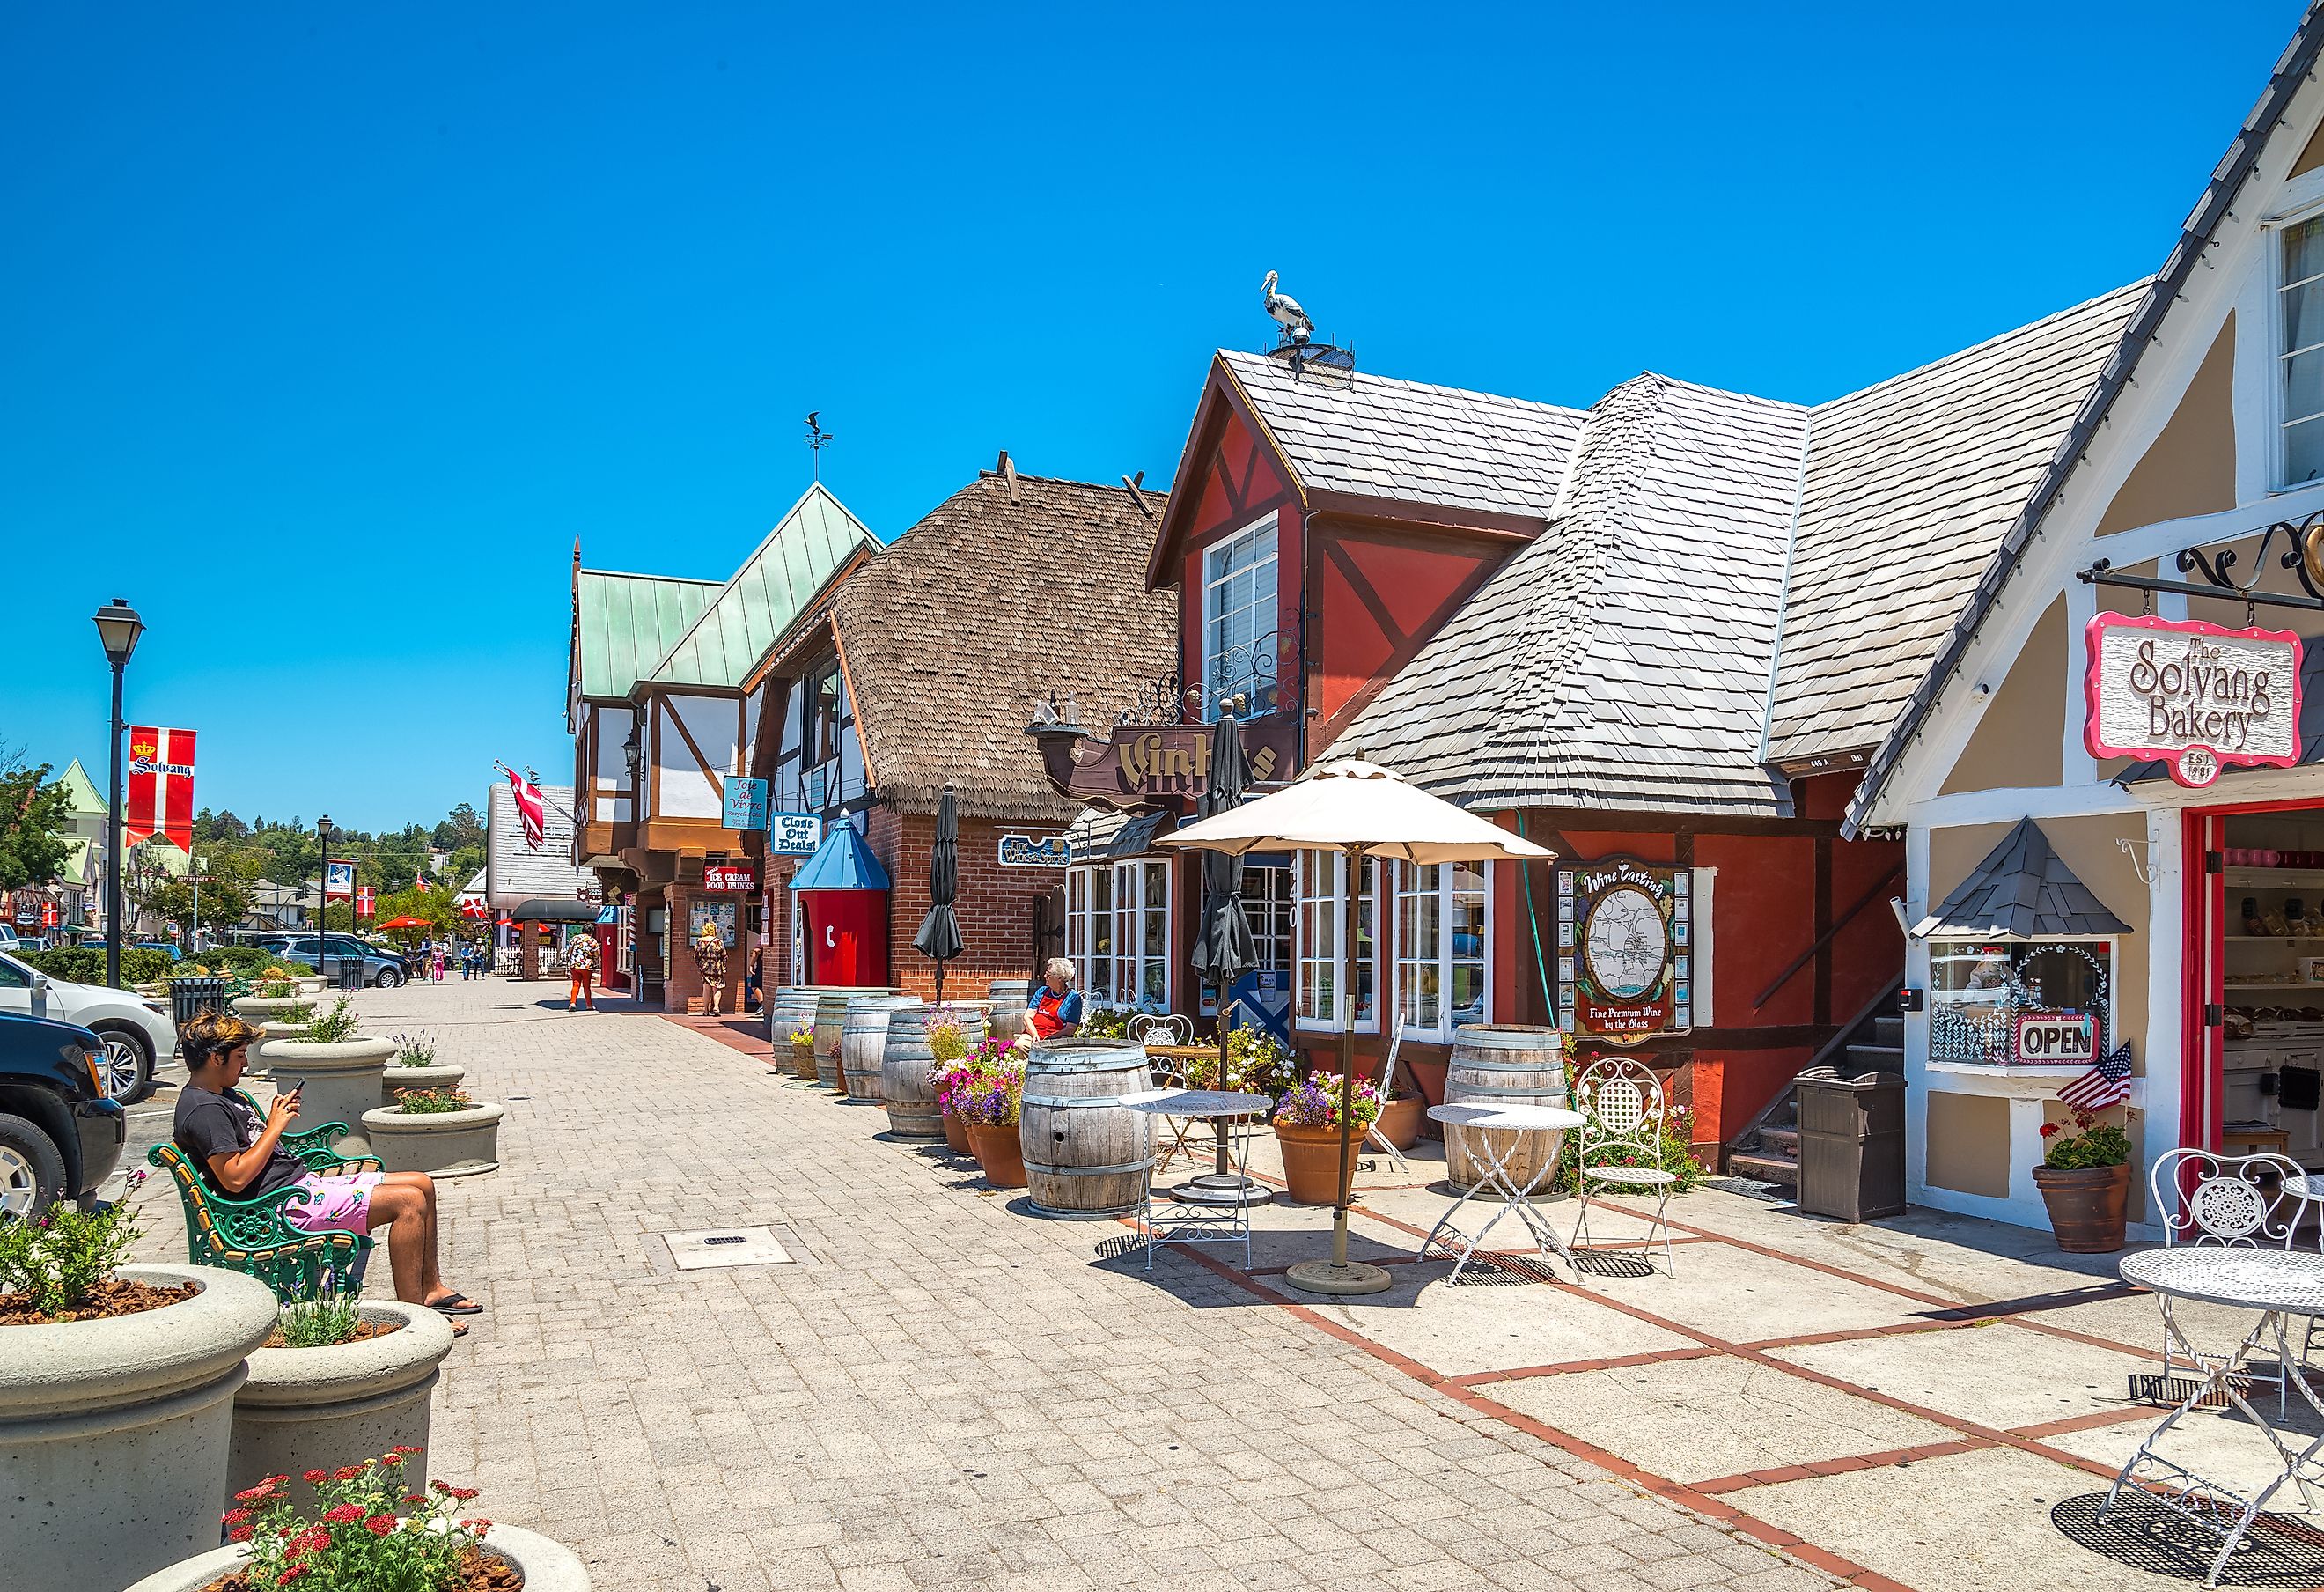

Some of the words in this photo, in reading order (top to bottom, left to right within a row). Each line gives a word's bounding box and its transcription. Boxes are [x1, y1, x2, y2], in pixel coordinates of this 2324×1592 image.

[2189, 636, 2221, 660] The
[2129, 639, 2271, 717] Solvang
[2149, 695, 2253, 750] Bakery
[1119, 732, 1277, 785] Vinhs
[2188, 753, 2210, 765] EST
[132, 756, 191, 778] Solvang
[2188, 766, 2210, 778] 1981
[733, 779, 758, 791] Joie
[739, 790, 753, 800] de
[728, 798, 762, 811] Vivre
[781, 816, 813, 829] Close
[785, 828, 809, 840] Out
[778, 837, 816, 851] Deals!
[1011, 839, 1029, 852] Fine
[724, 873, 751, 882] CREAM
[1583, 871, 1617, 894] Wine
[1617, 863, 1664, 899] Tasting
[727, 881, 754, 890] DRINKS
[1589, 1007, 1607, 1019] Fine
[1607, 1006, 1642, 1018] Premium
[1642, 1005, 1662, 1017] Wine
[1604, 1019, 1614, 1030] by
[1614, 1018, 1626, 1029] the
[1628, 1018, 1649, 1029] Glass
[2024, 1026, 2092, 1055] OPEN
